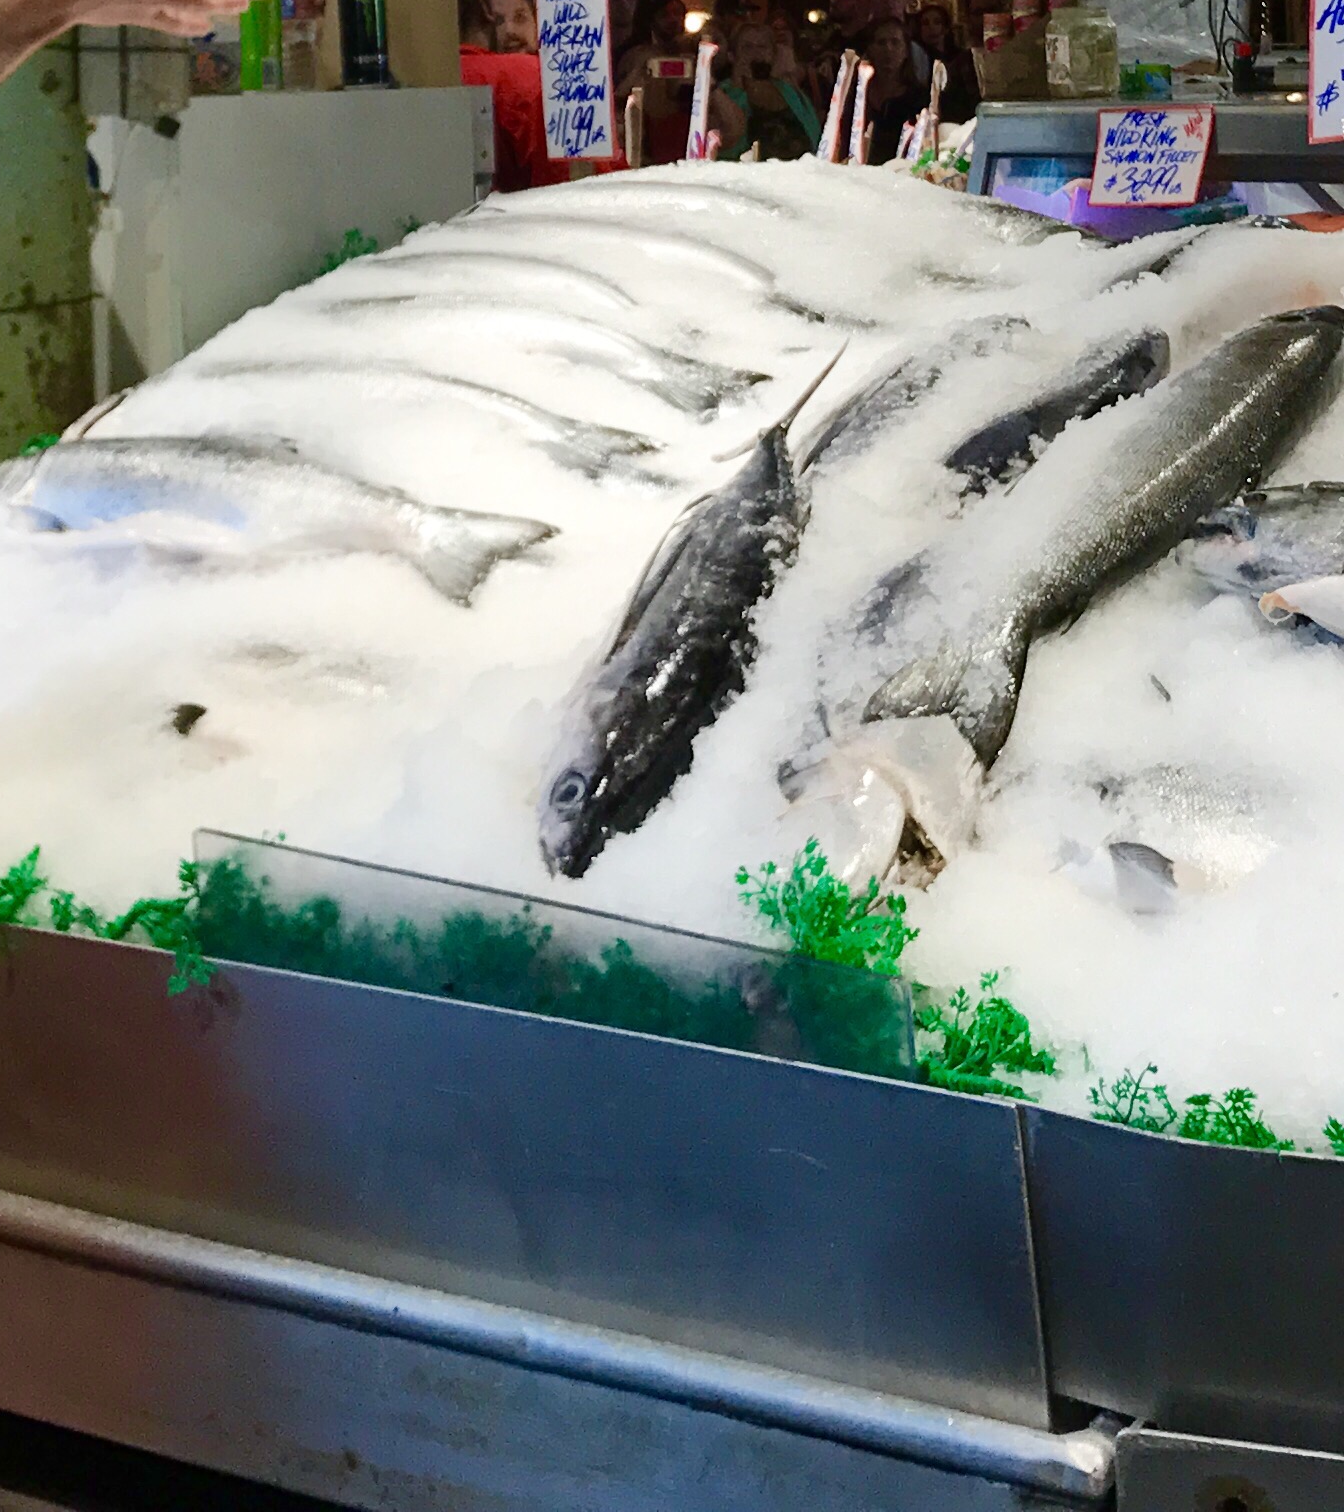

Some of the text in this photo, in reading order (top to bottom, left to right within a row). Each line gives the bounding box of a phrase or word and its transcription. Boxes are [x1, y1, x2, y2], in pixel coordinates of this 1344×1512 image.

[553, 2, 589, 26] WILD
[538, 17, 605, 51] ALASKAN
[547, 48, 599, 74] SILVER
[548, 76, 606, 105] SALMON
[1118, 109, 1169, 129] FRESH
[1104, 126, 1178, 149] WILD KING
[1102, 149, 1203, 167] SALMON FILLET
